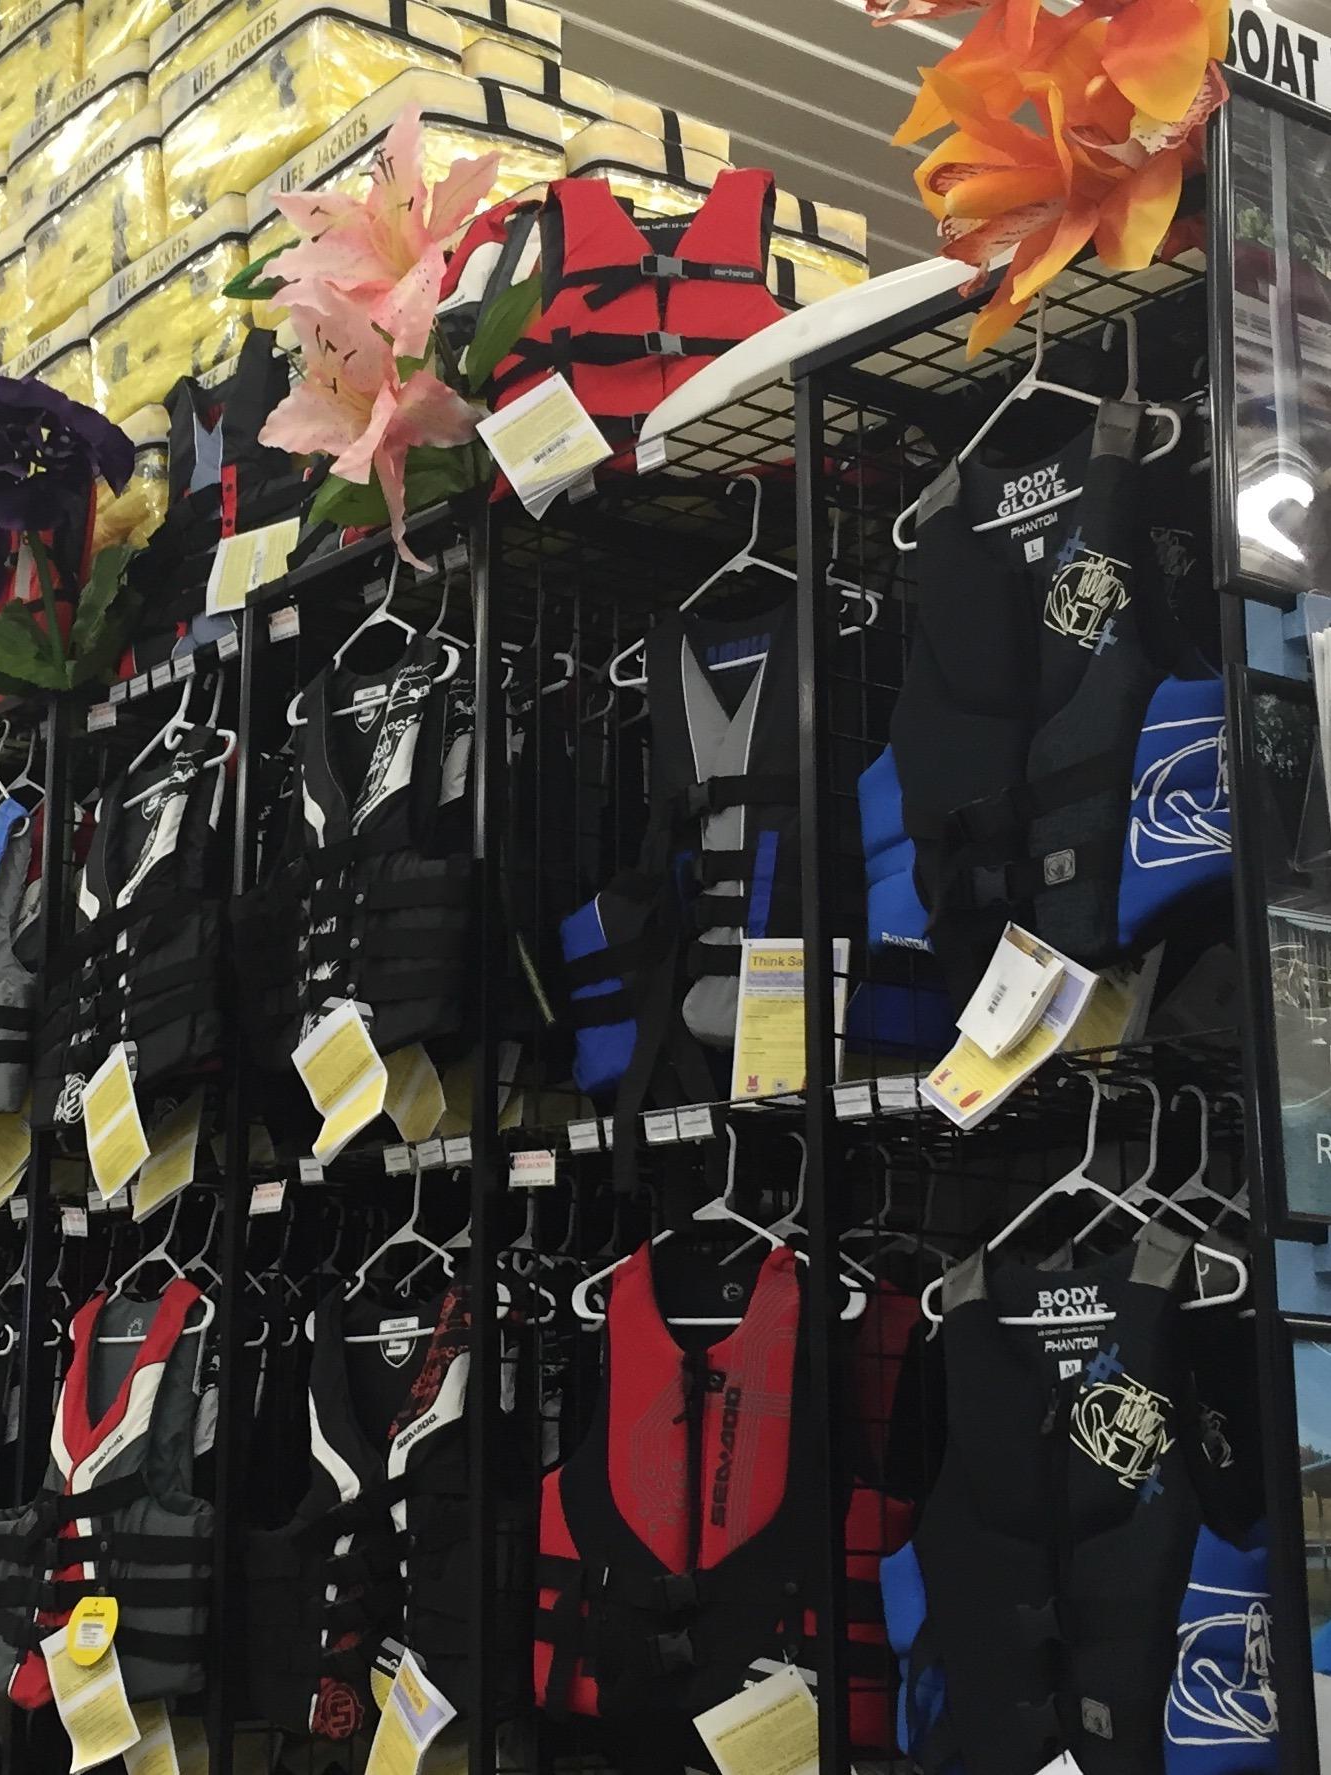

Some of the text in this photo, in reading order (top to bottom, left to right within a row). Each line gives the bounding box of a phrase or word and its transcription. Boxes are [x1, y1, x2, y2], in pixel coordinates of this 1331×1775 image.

[177, 6, 198, 32] LIFE
[192, 11, 278, 95] LIFE JACKETS
[30, 73, 97, 138] LIFE JACKETS
[280, 113, 368, 193] LIFE JACKETS
[118, 232, 189, 301] LIFE JACKETS
[997, 478, 1067, 517] GLOVE
[1003, 463, 1060, 499] BODY
[1010, 512, 1059, 540] PHANTOM
[752, 955, 785, 968] Think
[1037, 1285, 1099, 1308] BODY
[1044, 1335, 1099, 1353] PHANTOM
